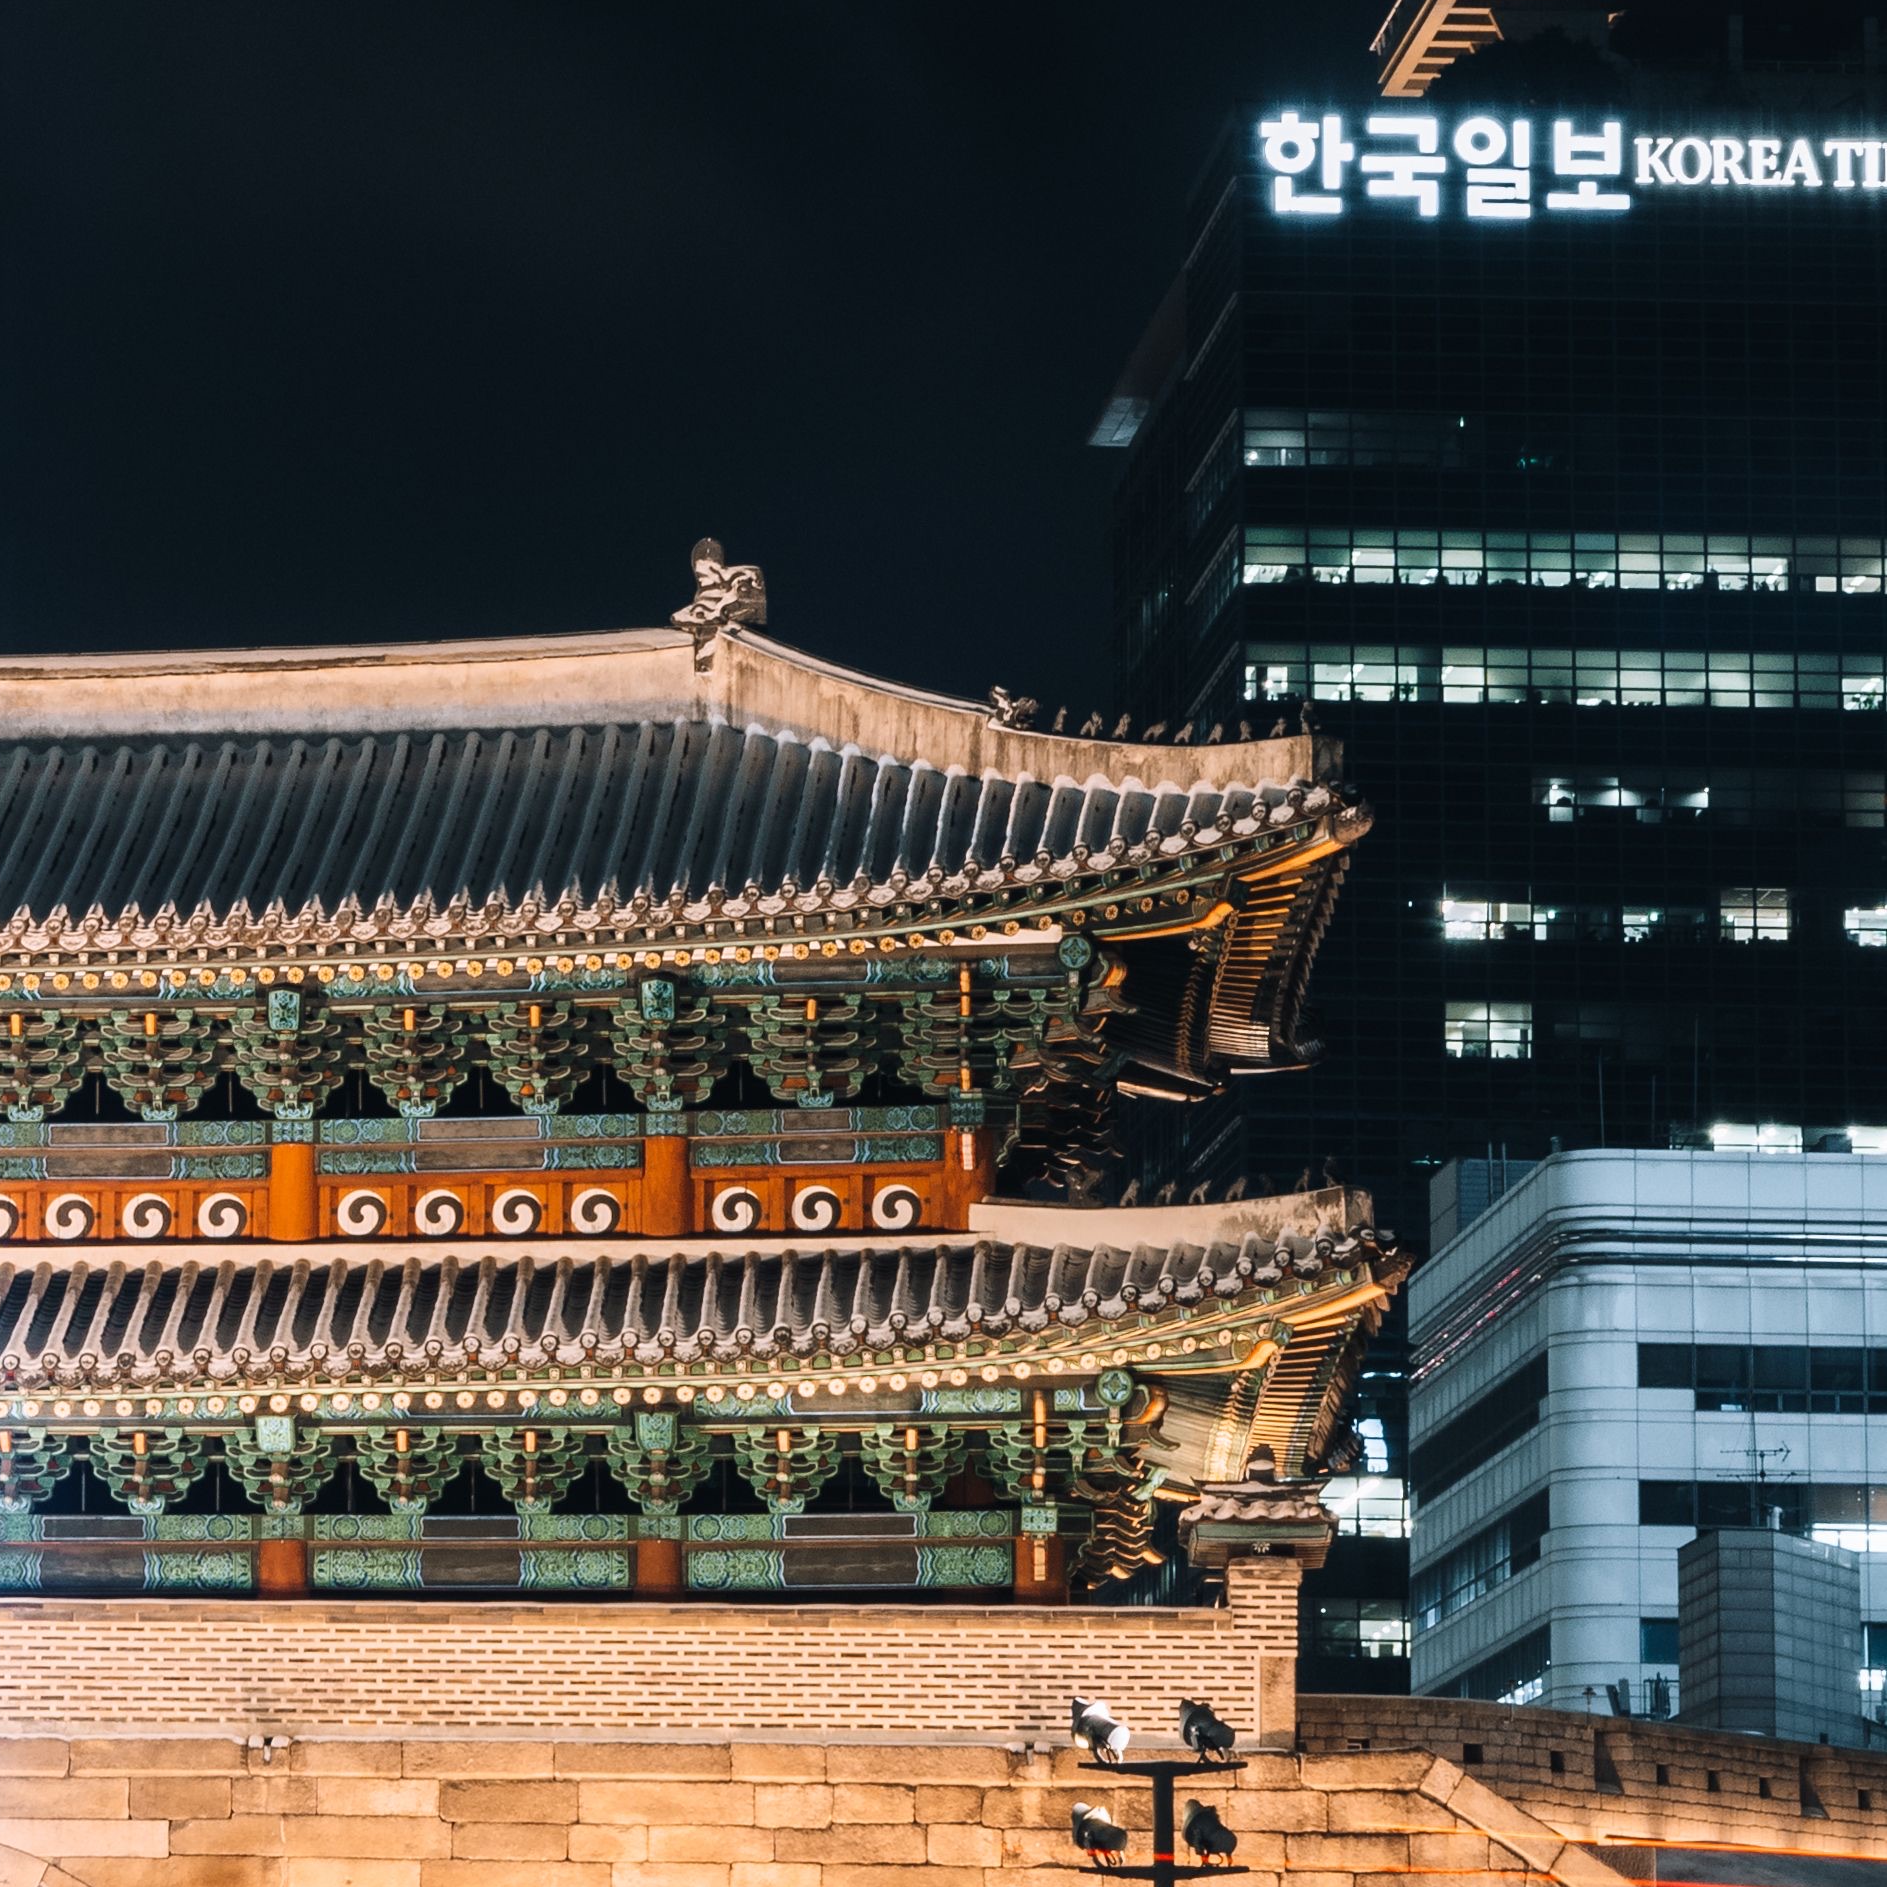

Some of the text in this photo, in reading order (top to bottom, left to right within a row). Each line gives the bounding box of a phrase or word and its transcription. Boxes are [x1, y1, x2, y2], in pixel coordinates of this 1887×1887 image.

[1260, 111, 1887, 219] 한국일보 KOREA TI
